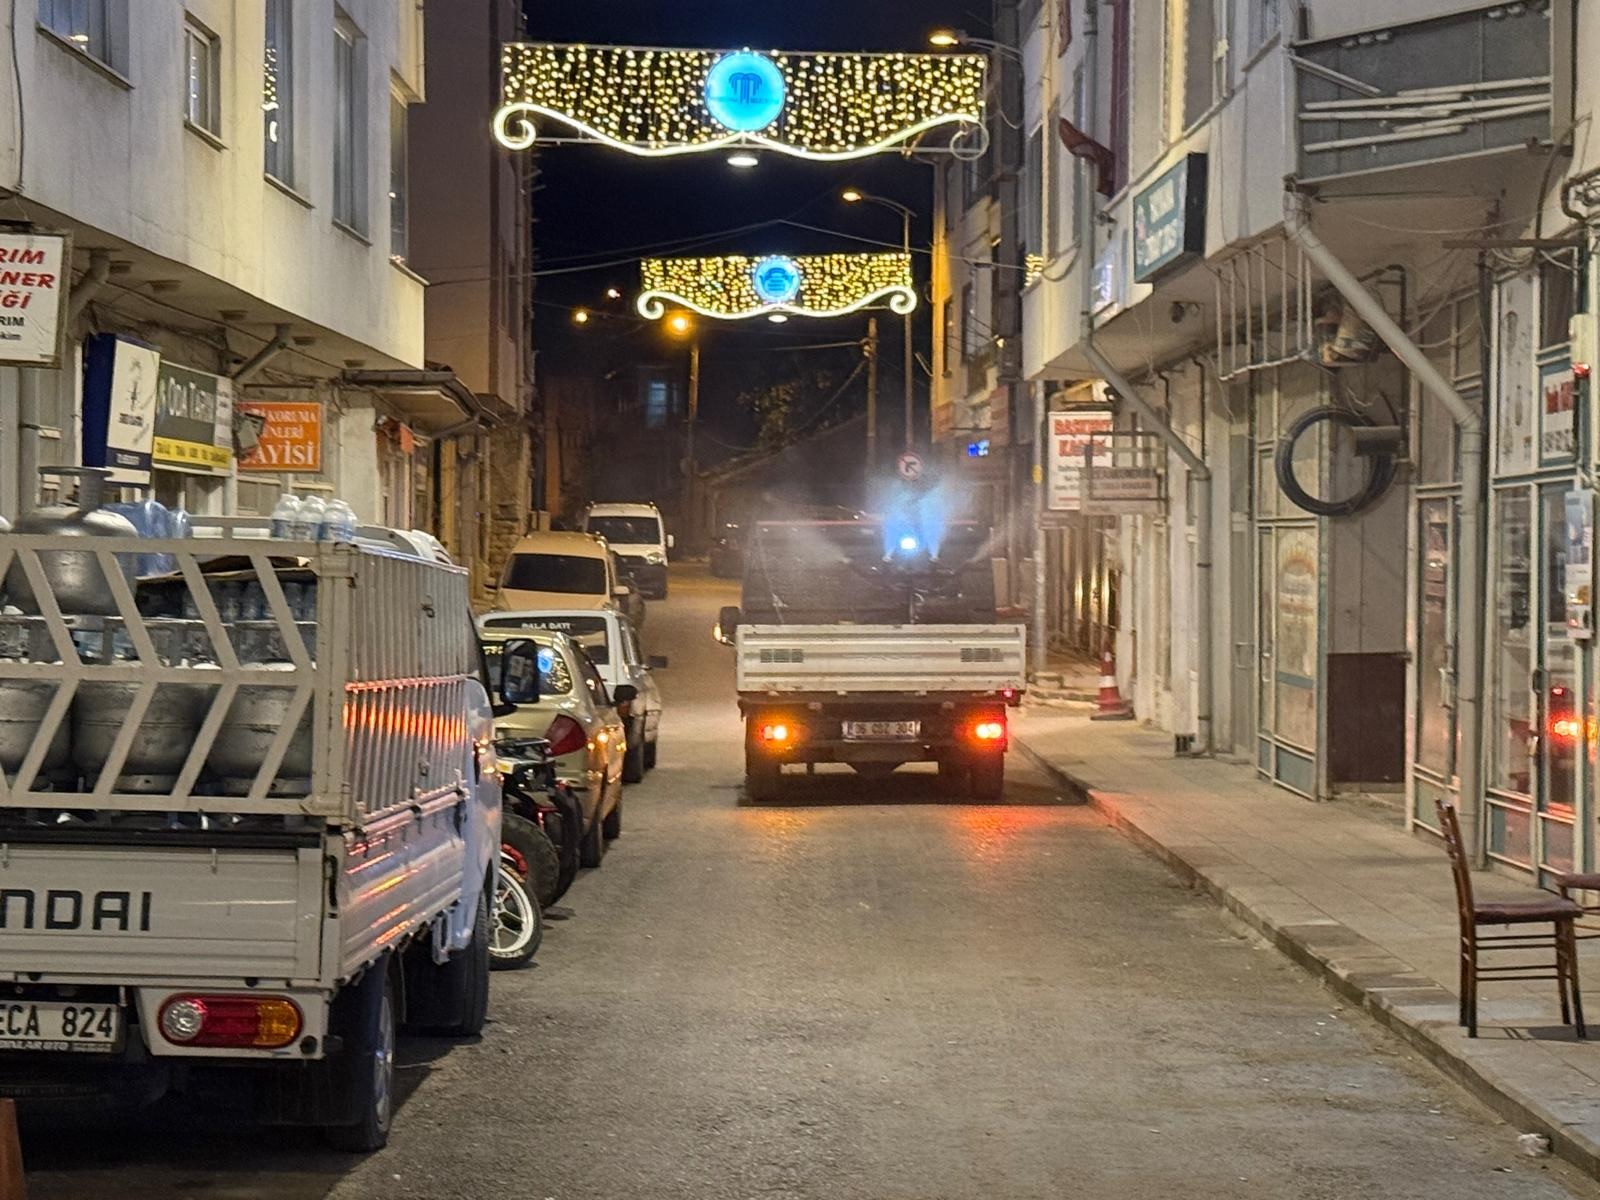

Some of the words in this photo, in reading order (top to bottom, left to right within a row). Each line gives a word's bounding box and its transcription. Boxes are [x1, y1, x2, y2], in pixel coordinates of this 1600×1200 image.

[0, 288, 32, 309] Ğİ
[240, 440, 314, 465] AYİSİ
[62, 1006, 113, 1038] 824
